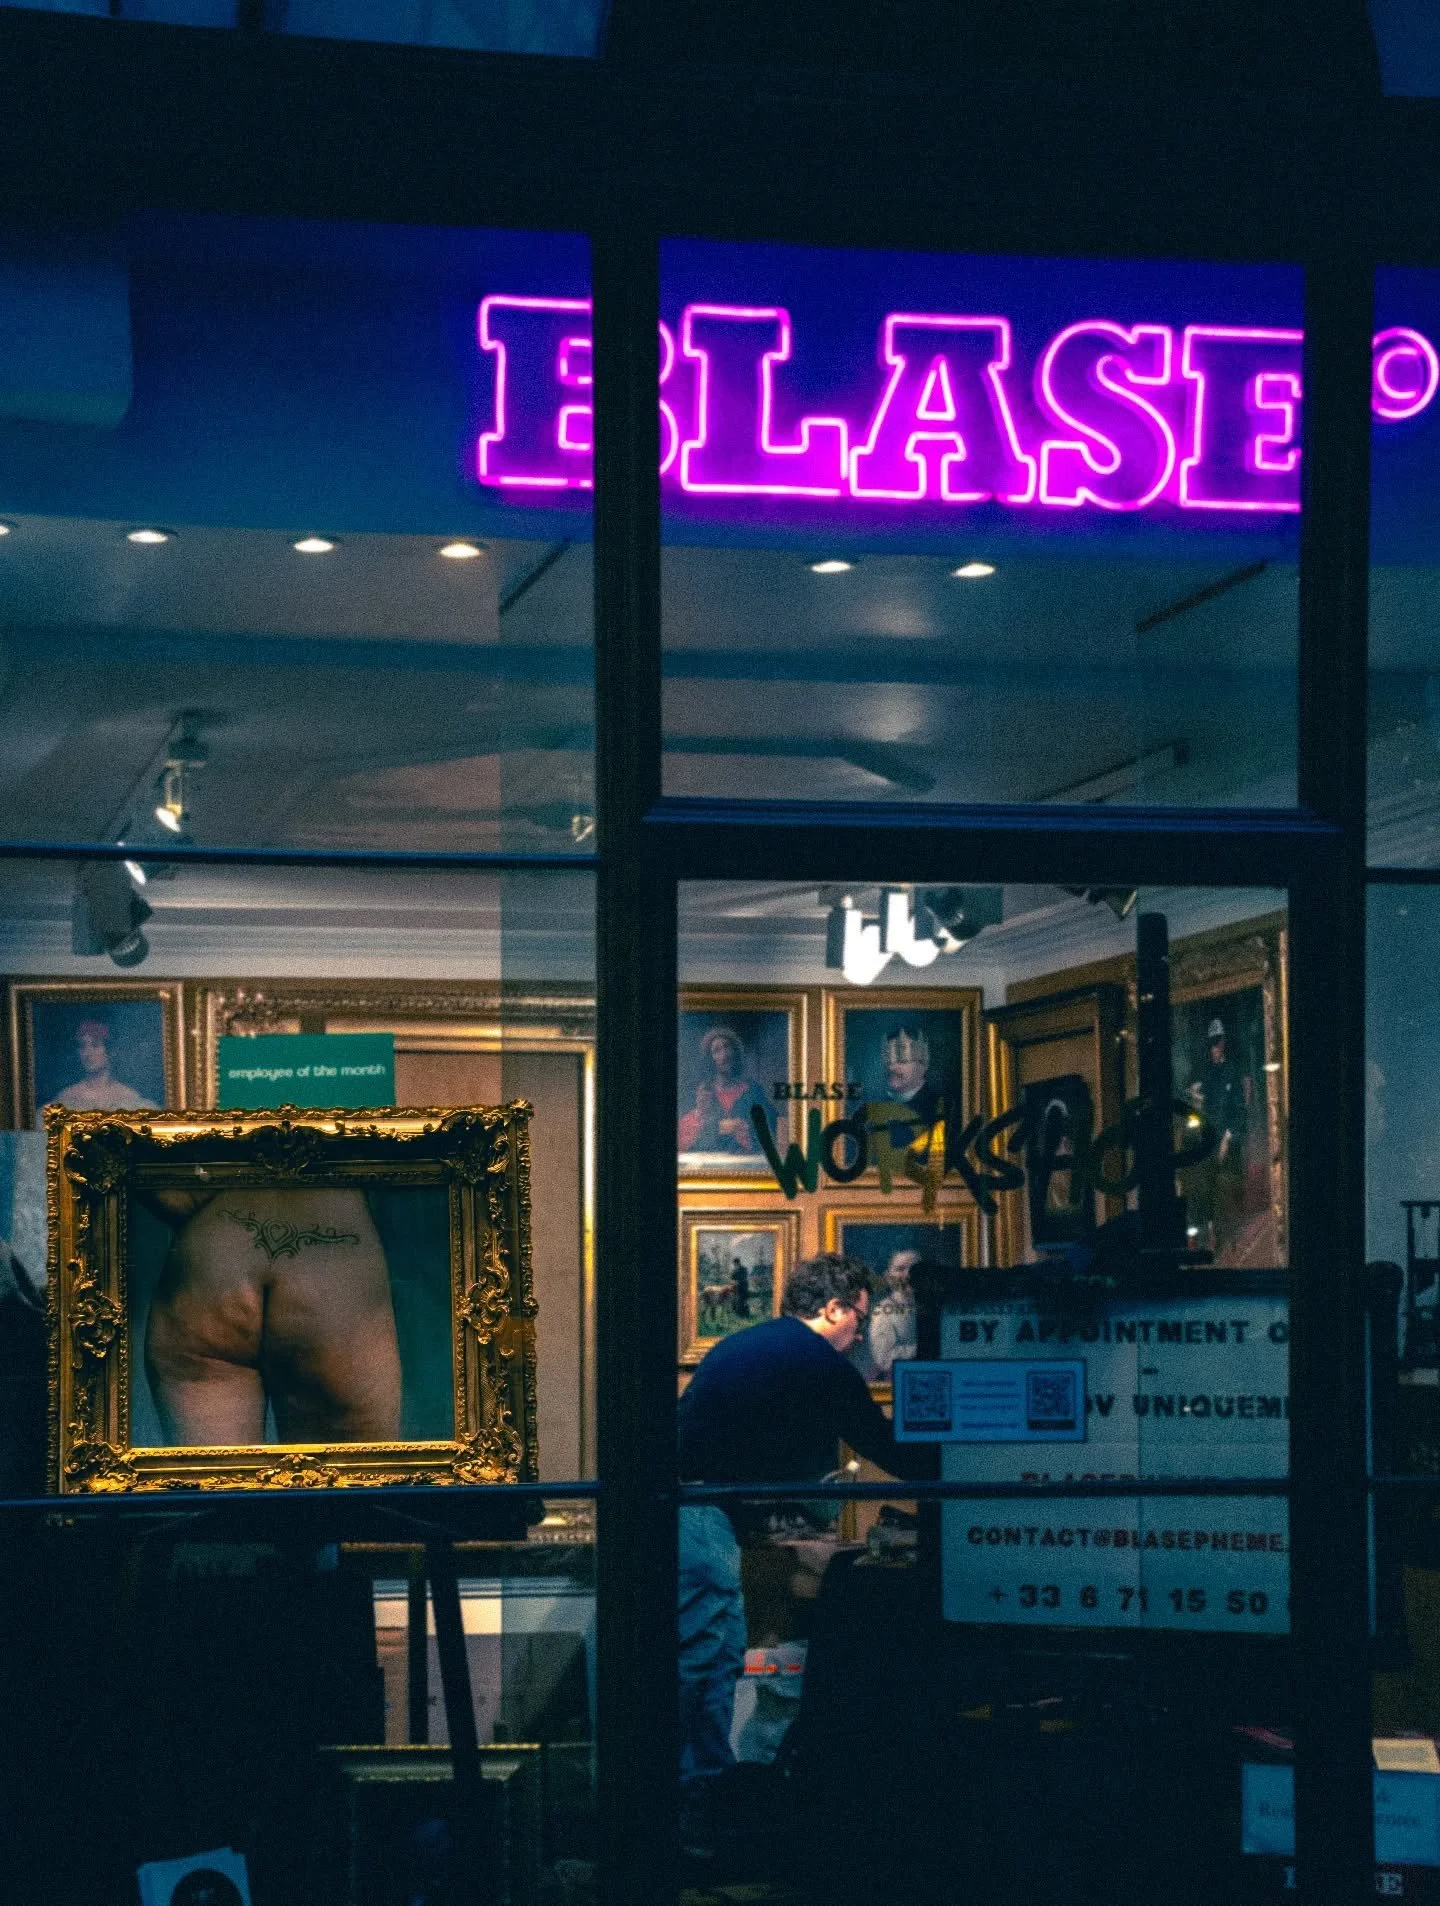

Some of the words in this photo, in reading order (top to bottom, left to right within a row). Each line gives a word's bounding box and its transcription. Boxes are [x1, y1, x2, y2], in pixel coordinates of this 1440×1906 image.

[227, 1066, 294, 1081] employee
[296, 1066, 310, 1077] of
[313, 1065, 337, 1077] the
[340, 1064, 386, 1077] month
[773, 1081, 862, 1101] BLASE
[959, 1319, 998, 1343] BY
[1132, 1394, 1290, 1419] UNIQUEM
[1019, 1583, 1061, 1610] 33
[1079, 1584, 1100, 1610] 6
[1117, 1586, 1149, 1612] 71
[1169, 1587, 1207, 1614] 15
[1226, 1589, 1269, 1616] 50
